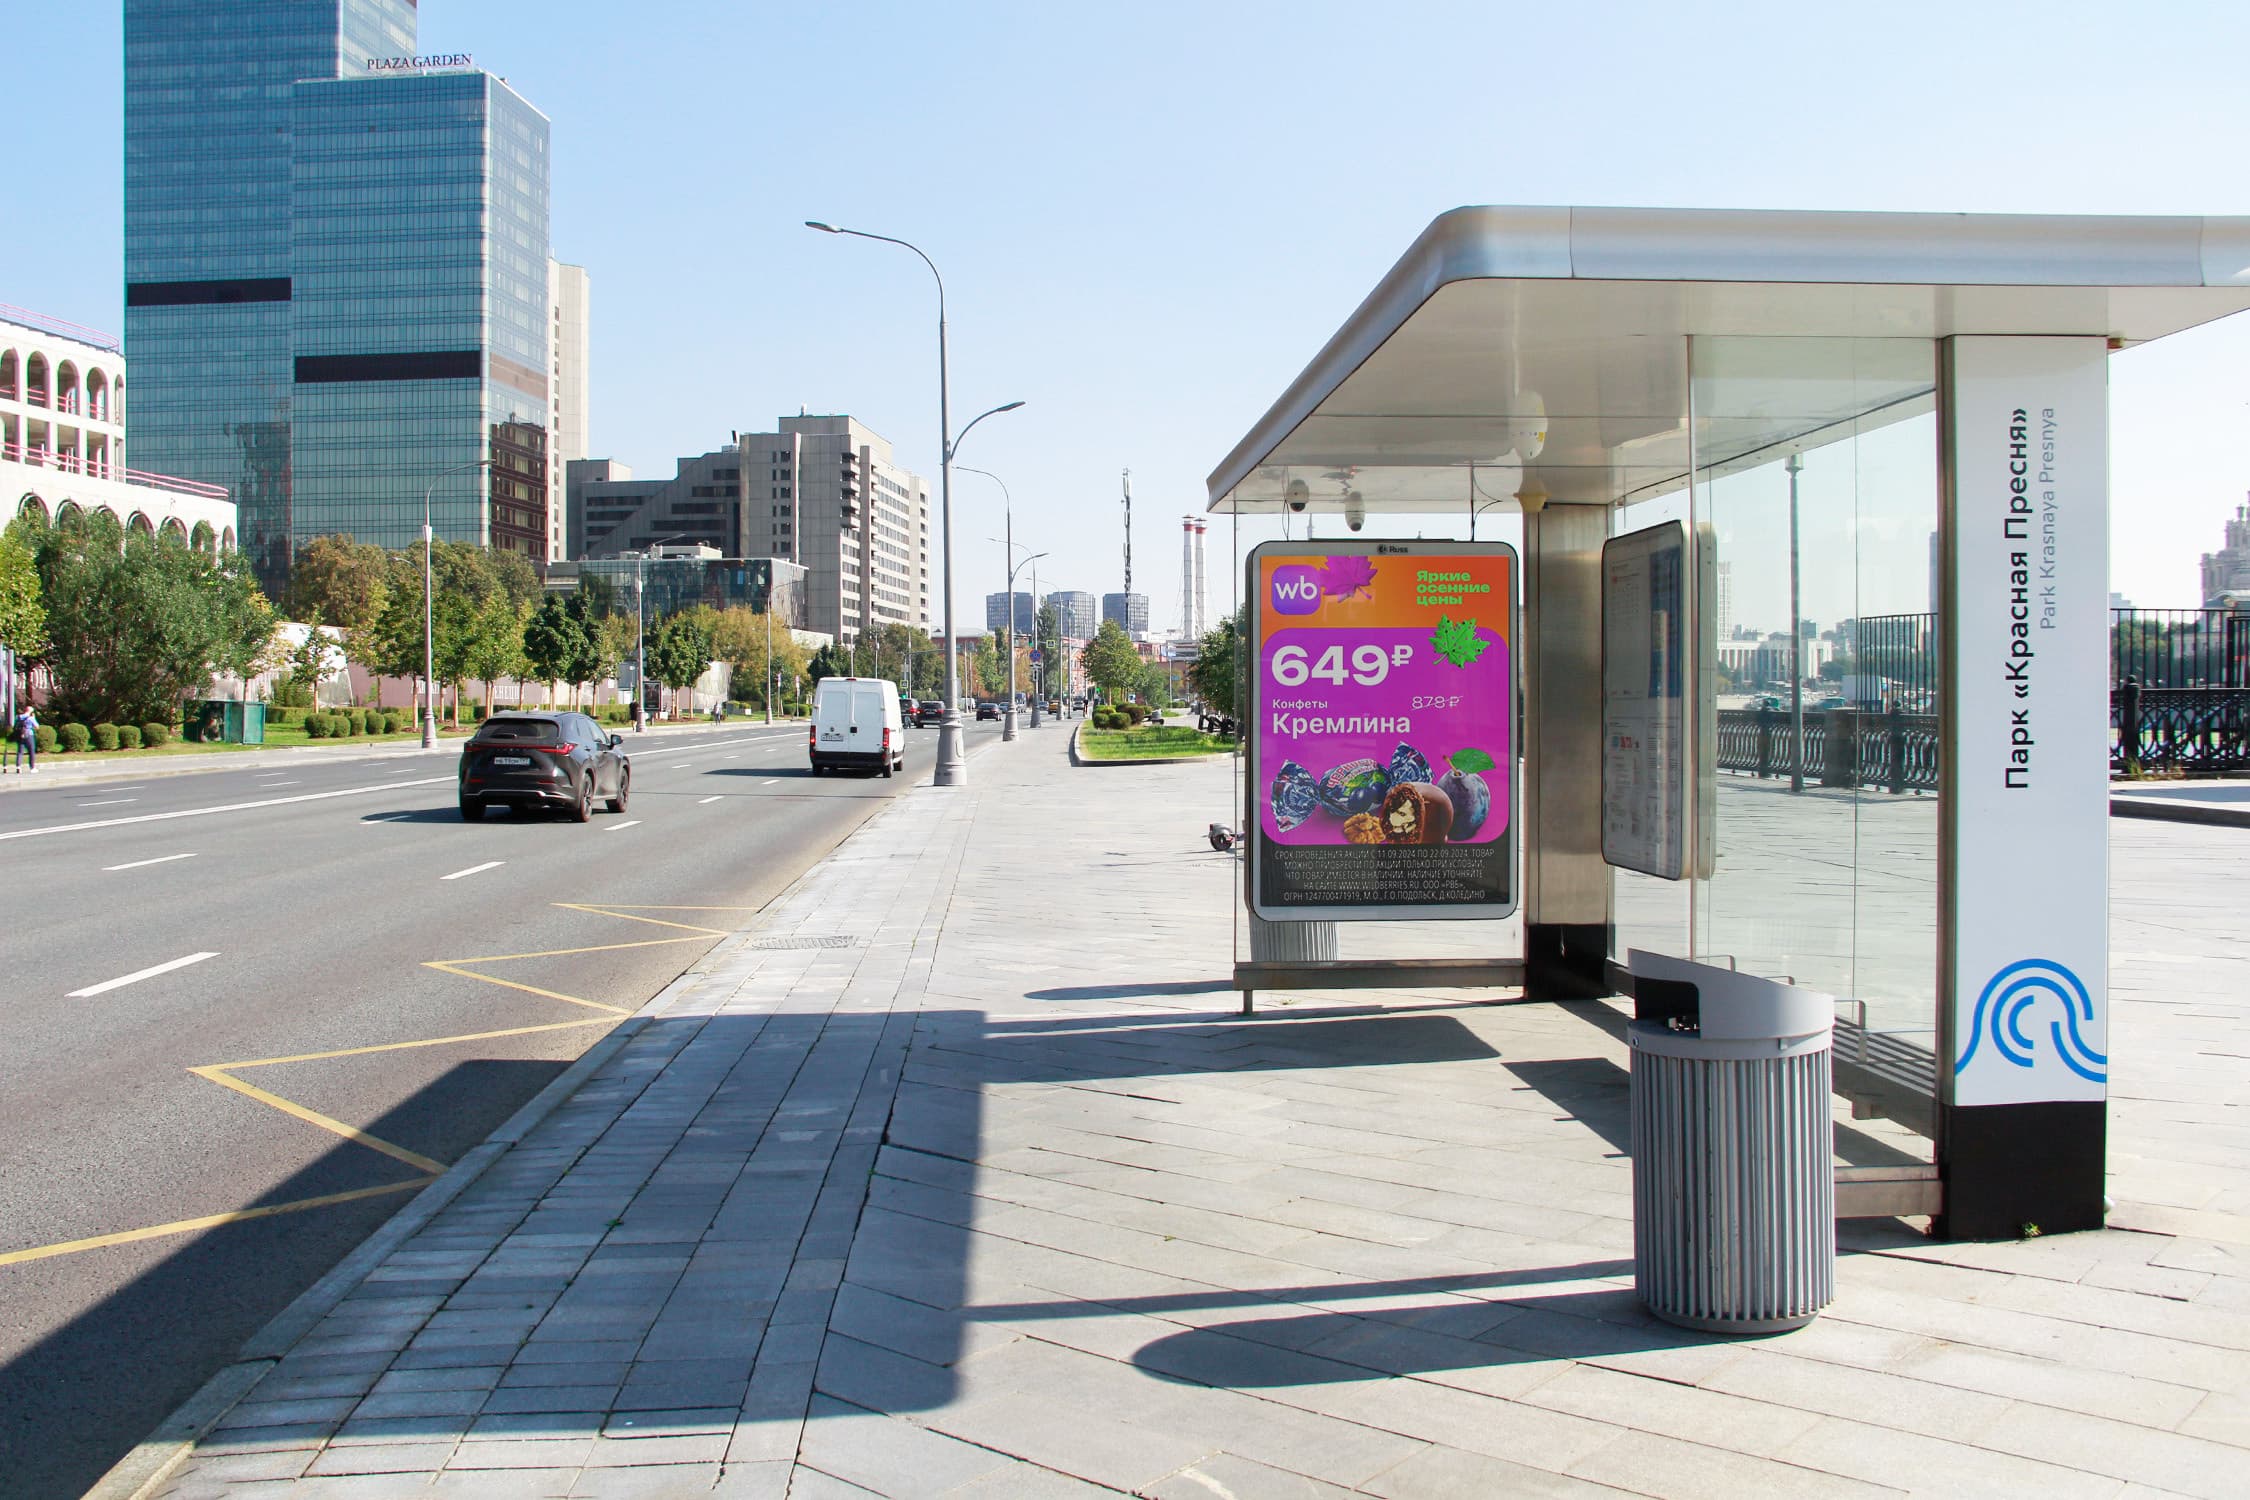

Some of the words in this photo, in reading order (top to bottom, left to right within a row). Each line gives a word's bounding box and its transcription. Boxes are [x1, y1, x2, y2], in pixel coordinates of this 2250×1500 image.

[367, 58, 409, 70] PLAZA
[413, 54, 472, 68] GARDEN
[2039, 407, 2058, 484] Presnya
[2004, 408, 2033, 540] Пресня»
[2039, 491, 2058, 578] Krasnaya
[1416, 571, 1471, 583] Яркие
[1275, 575, 1318, 601] wb
[1416, 583, 1491, 593] осенние
[1416, 595, 1463, 605] цены
[2040, 585, 2056, 630] Park
[2005, 550, 2034, 700] «Красная
[1272, 699, 1328, 711] Конфеты
[1272, 713, 1411, 739] Кремлина
[2005, 708, 2034, 789] Парк
[1274, 850, 1295, 860] СРОК
[1417, 849, 1428, 858] ПО
[1472, 848, 1495, 857] ТОВАР
[1402, 859, 1430, 869] ТОЛЬКО
[1284, 892, 1303, 901] ОГРН
